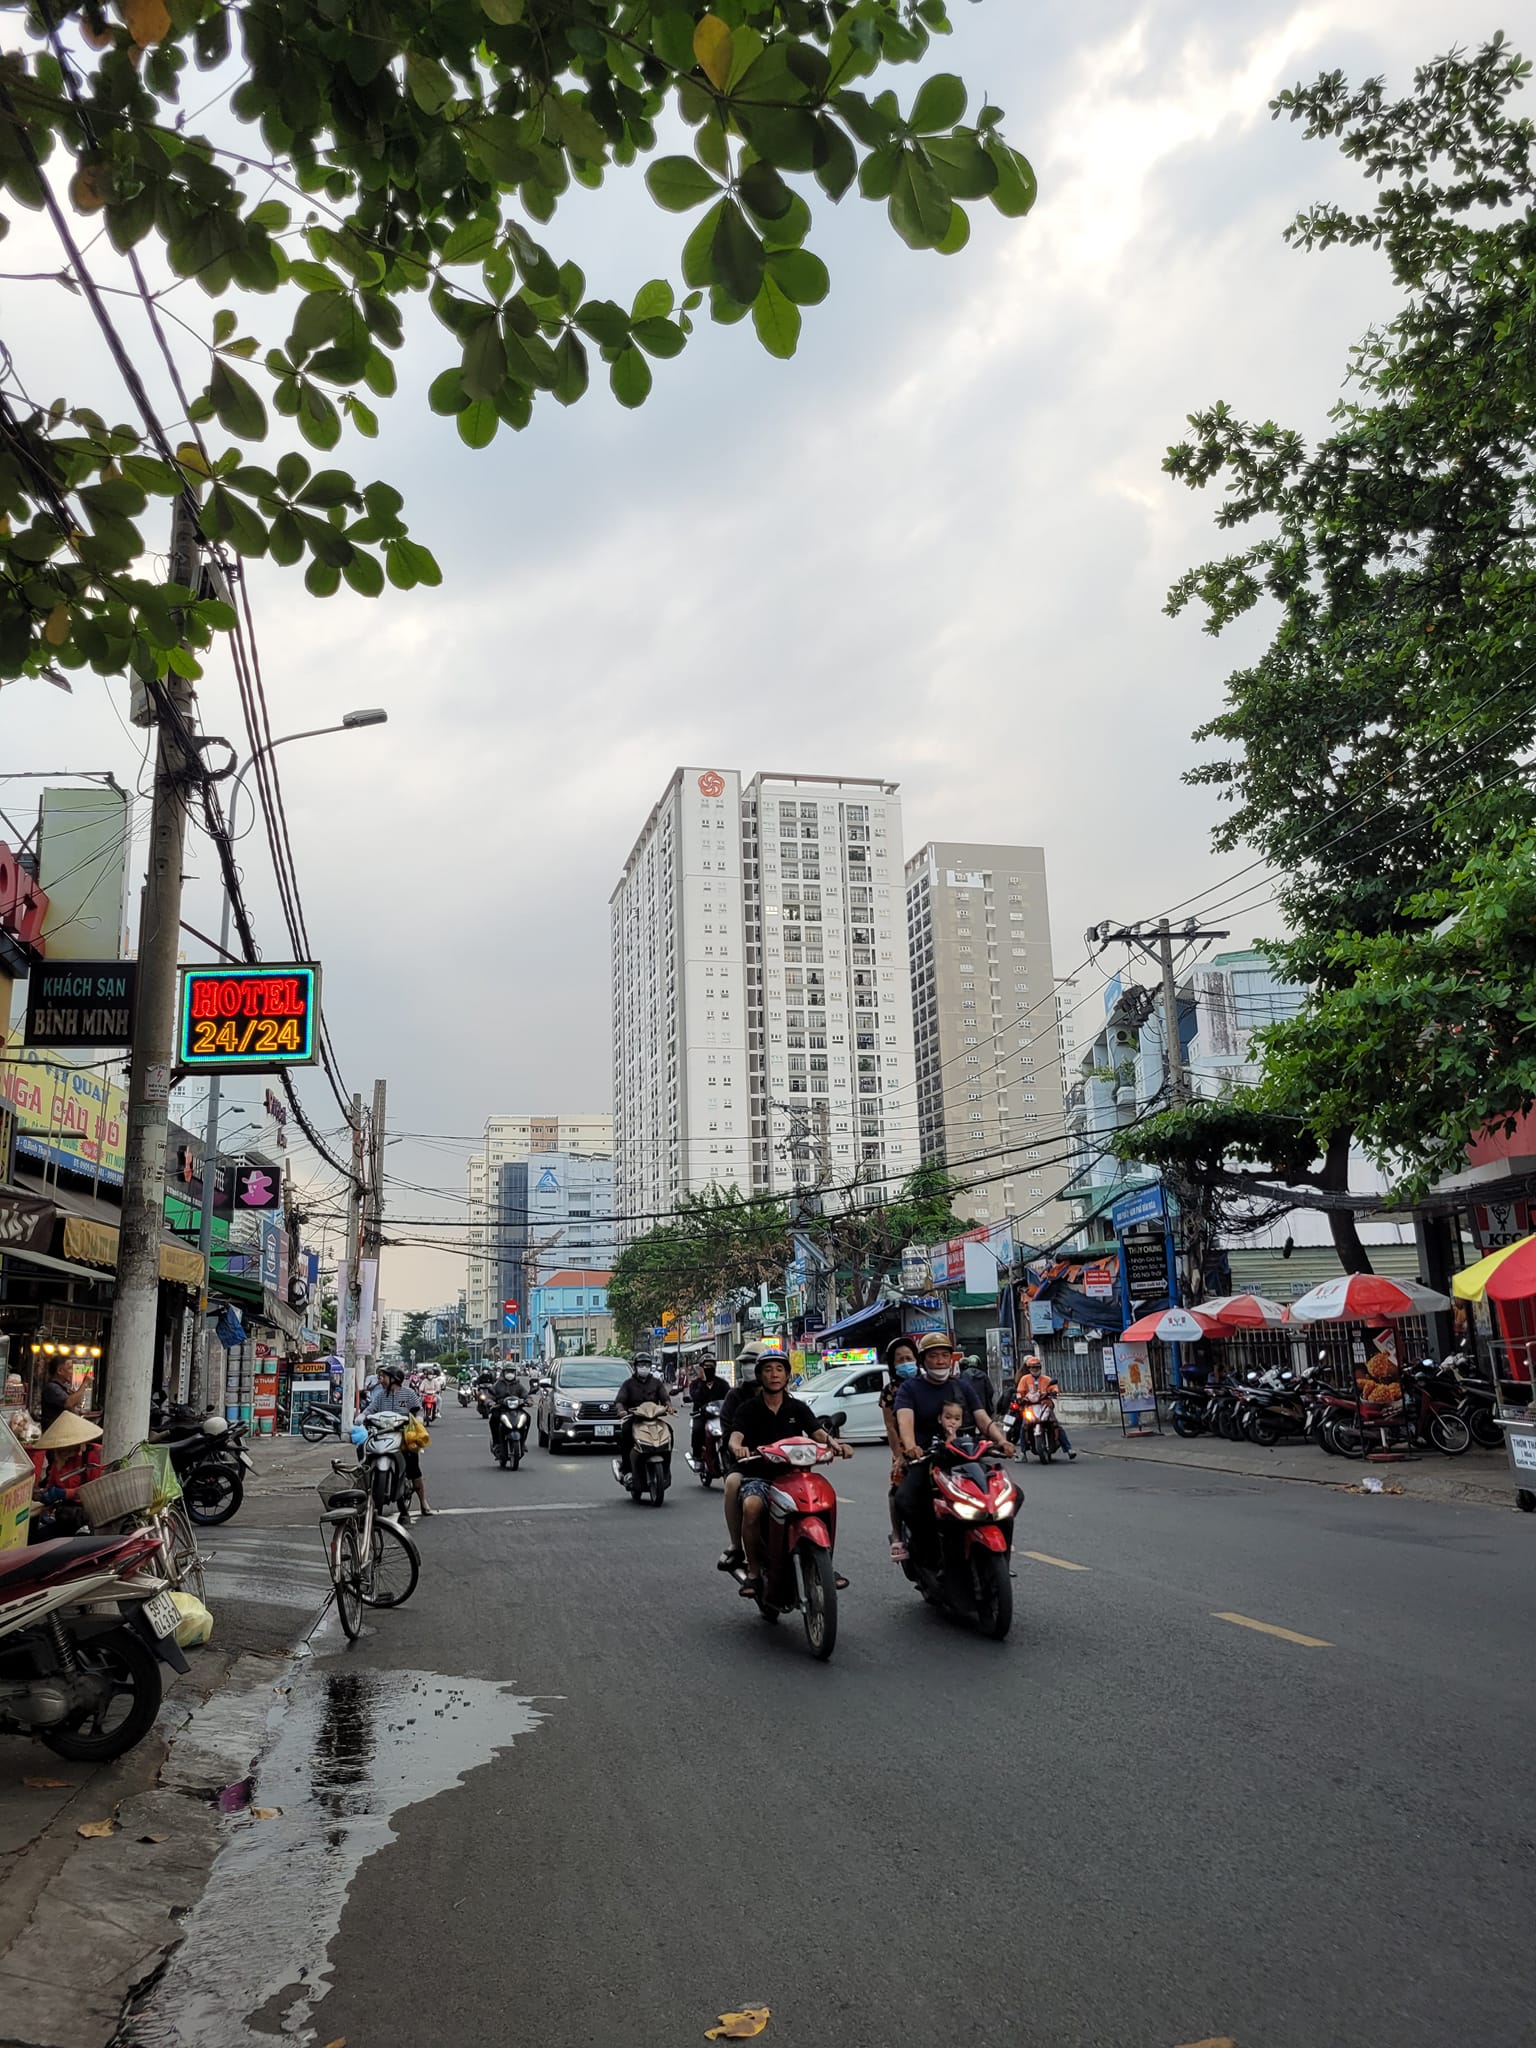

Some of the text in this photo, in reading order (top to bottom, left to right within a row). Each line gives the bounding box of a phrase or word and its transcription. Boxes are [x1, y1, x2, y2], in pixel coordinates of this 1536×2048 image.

[43, 972, 126, 1000] KHÁCH SẠN
[191, 979, 305, 1018] HOTEL
[81, 1008, 130, 1035] MINH
[193, 1019, 300, 1053] 24/24
[1488, 1232, 1523, 1246] KFC
